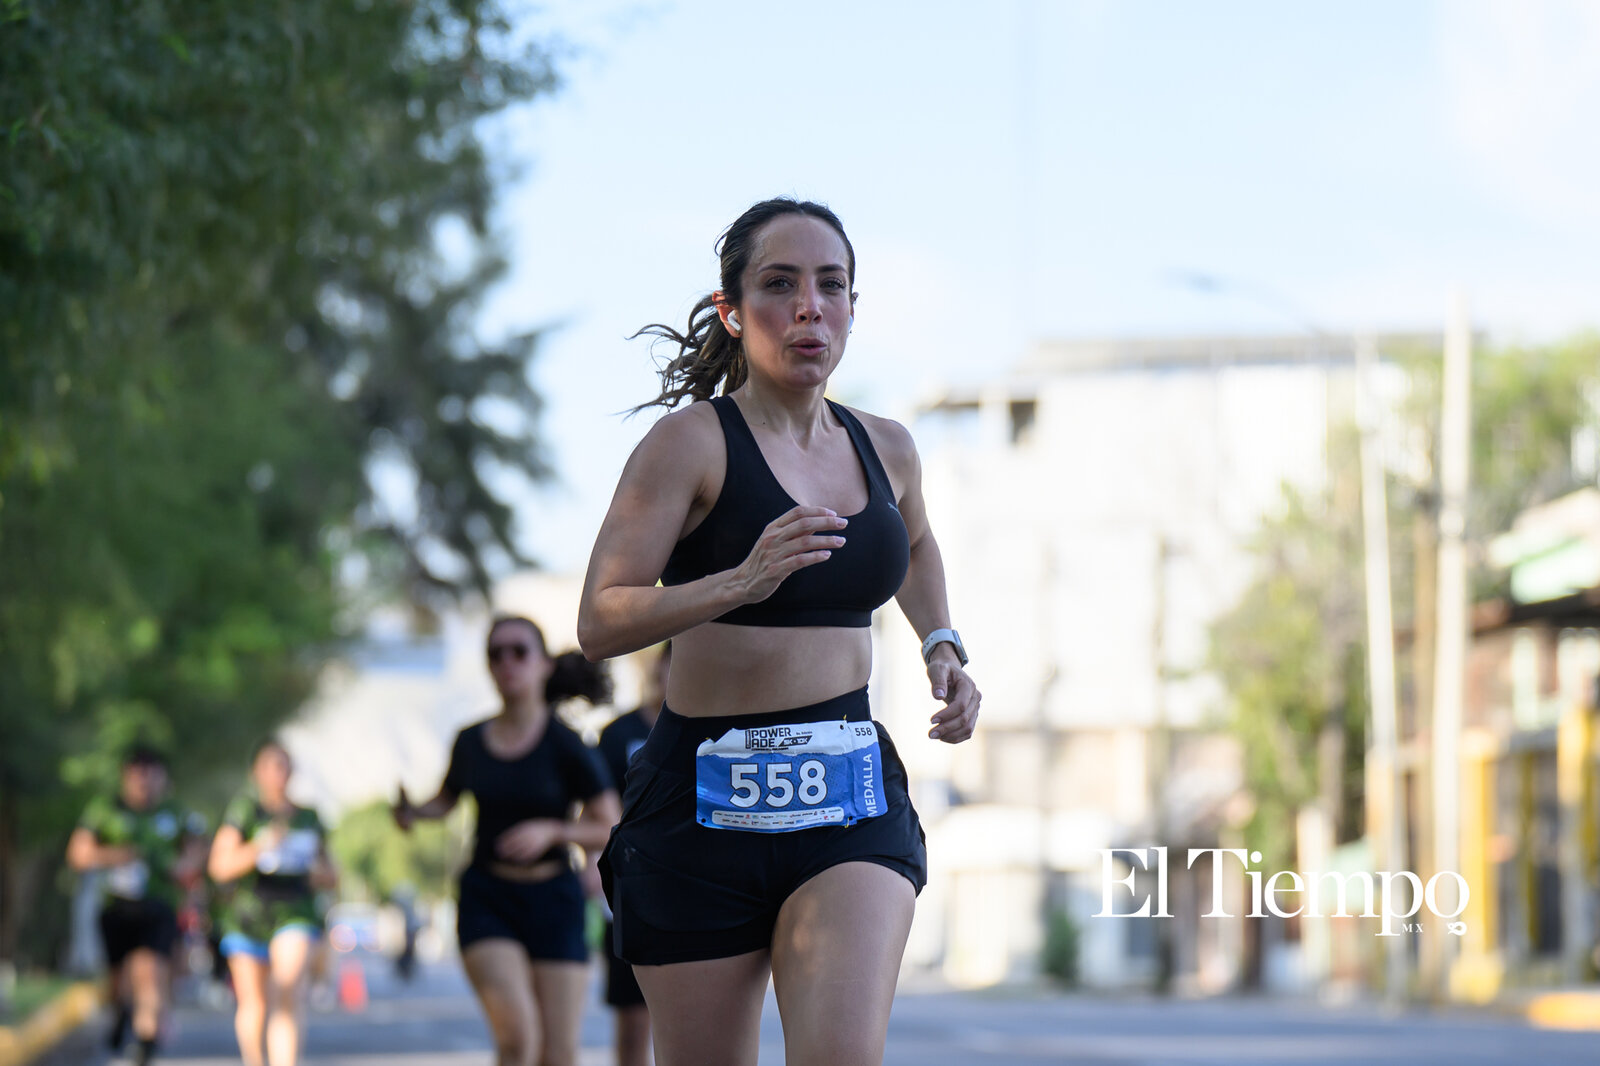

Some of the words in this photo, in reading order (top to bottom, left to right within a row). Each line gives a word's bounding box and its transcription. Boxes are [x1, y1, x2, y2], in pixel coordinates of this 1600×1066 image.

[751, 727, 792, 738] POWER
[855, 727, 872, 736] 558
[728, 758, 828, 808] 558
[863, 753, 878, 817] MEDALLA
